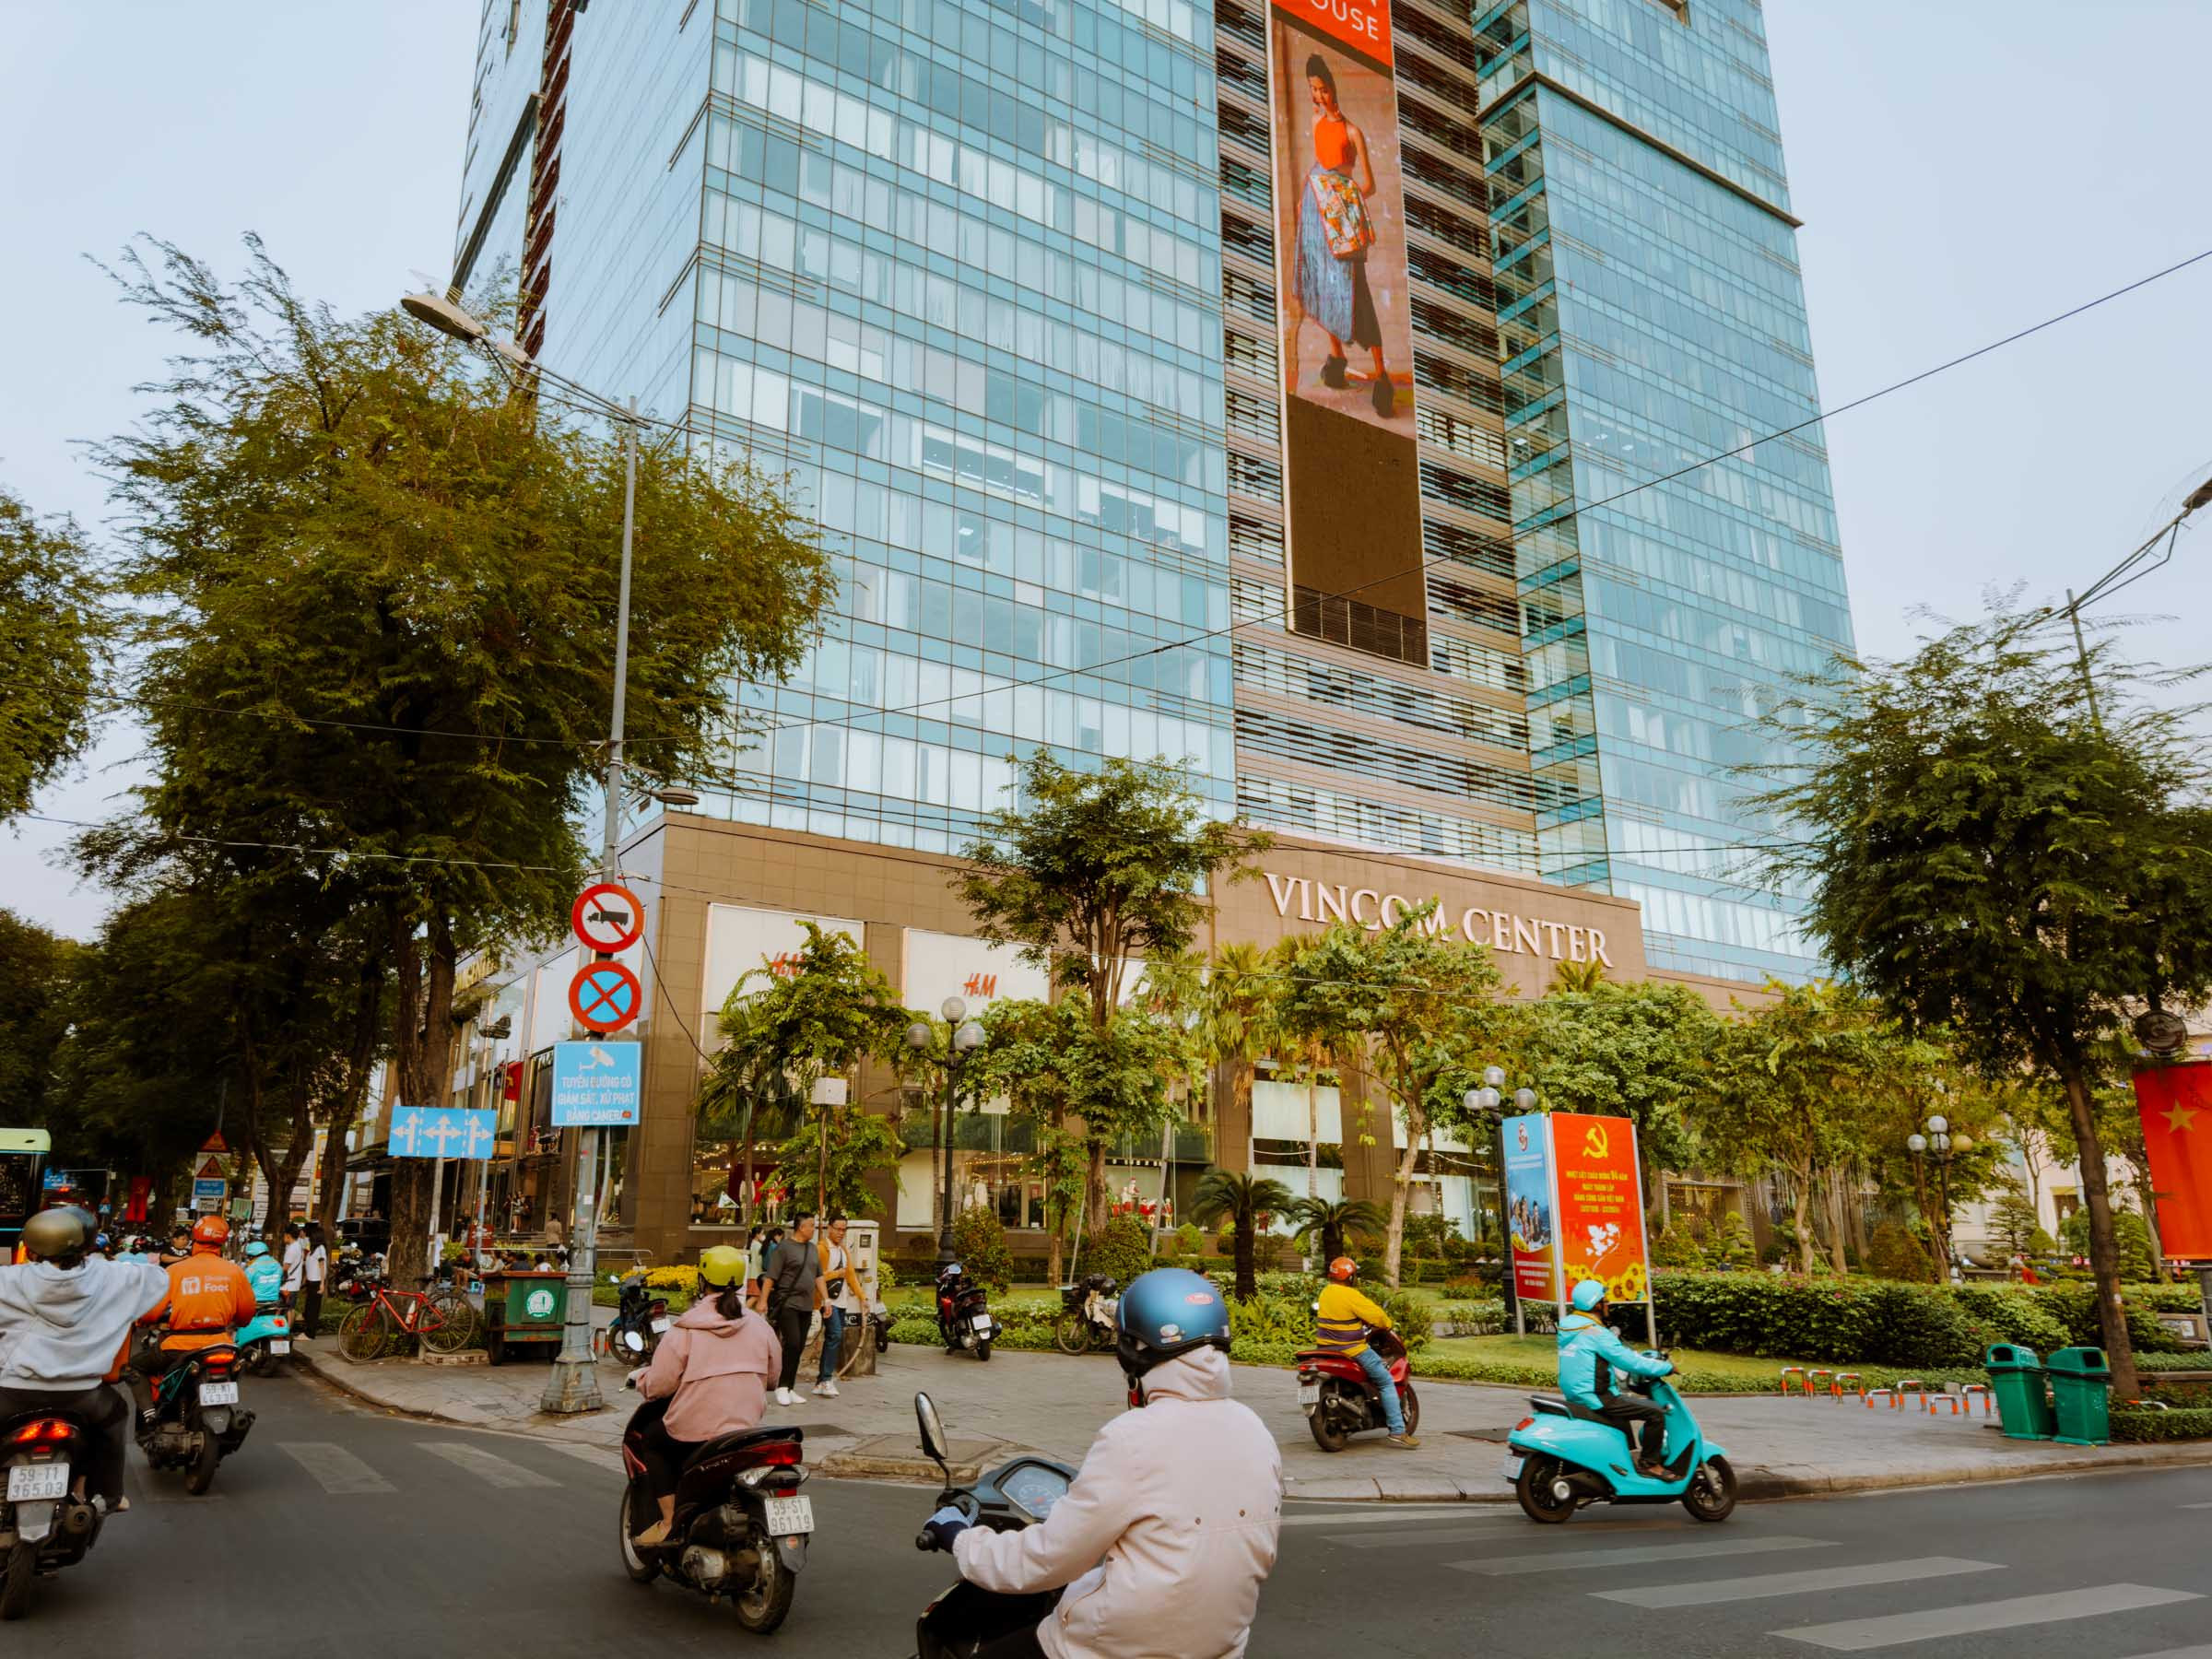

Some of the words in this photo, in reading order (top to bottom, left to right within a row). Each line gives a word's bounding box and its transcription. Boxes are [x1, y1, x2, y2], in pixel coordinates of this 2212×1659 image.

[1264, 872, 1452, 943] VINCOM
[1462, 907, 1614, 968] CENTER
[963, 972, 997, 999] H&M
[18, 1466, 58, 1482] 59-T1
